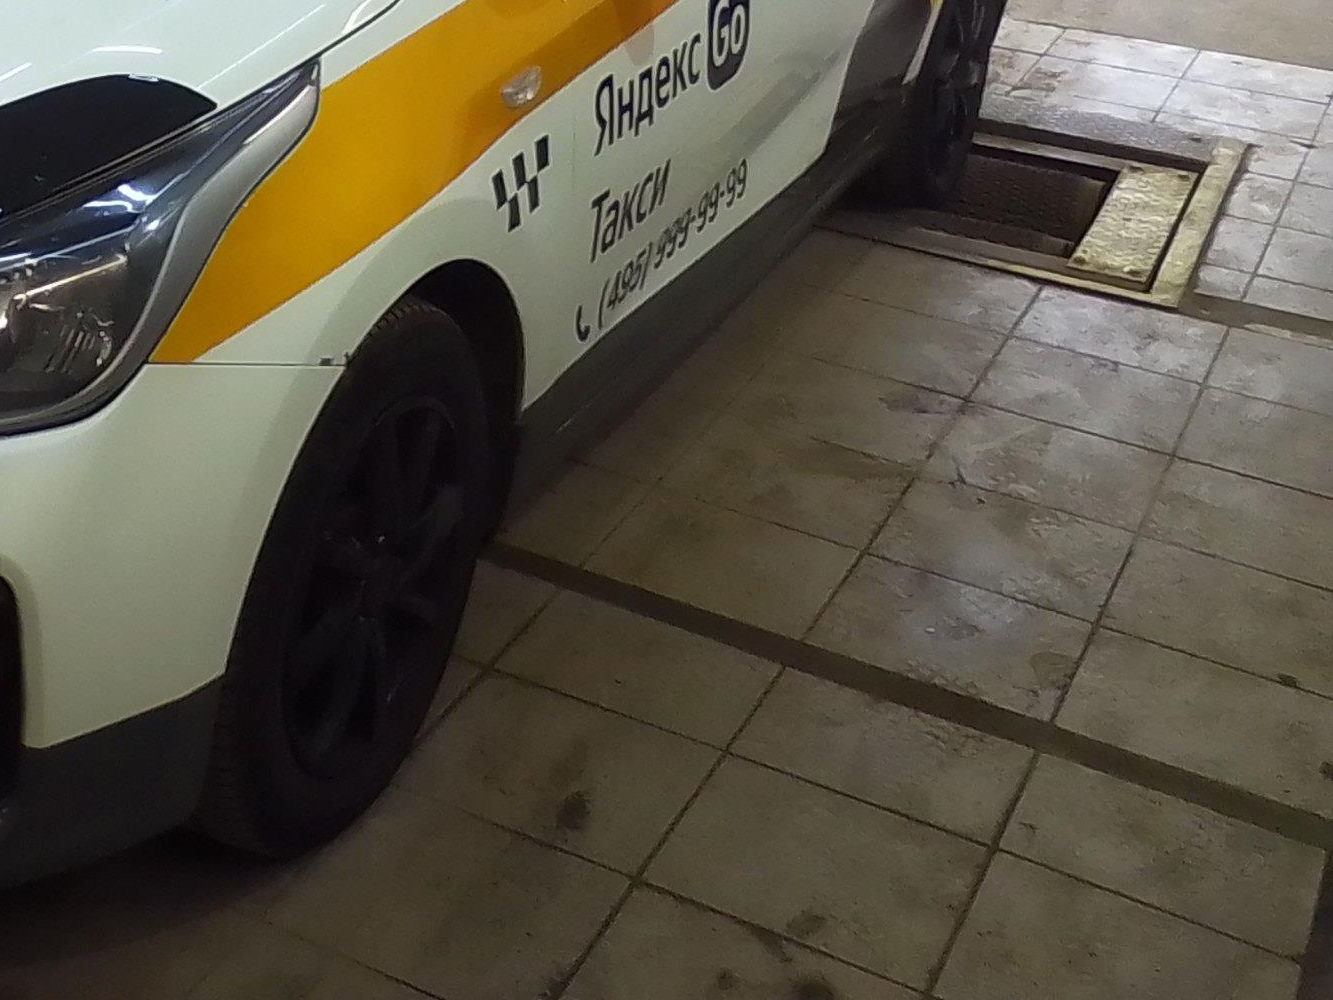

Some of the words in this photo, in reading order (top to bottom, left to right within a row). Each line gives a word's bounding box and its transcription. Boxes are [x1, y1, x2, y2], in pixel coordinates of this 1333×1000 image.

[594, 32, 702, 157] Яндекс
[591, 158, 671, 263] Такси
[598, 241, 653, 330] (495)
[653, 158, 747, 269] 999-99-99
